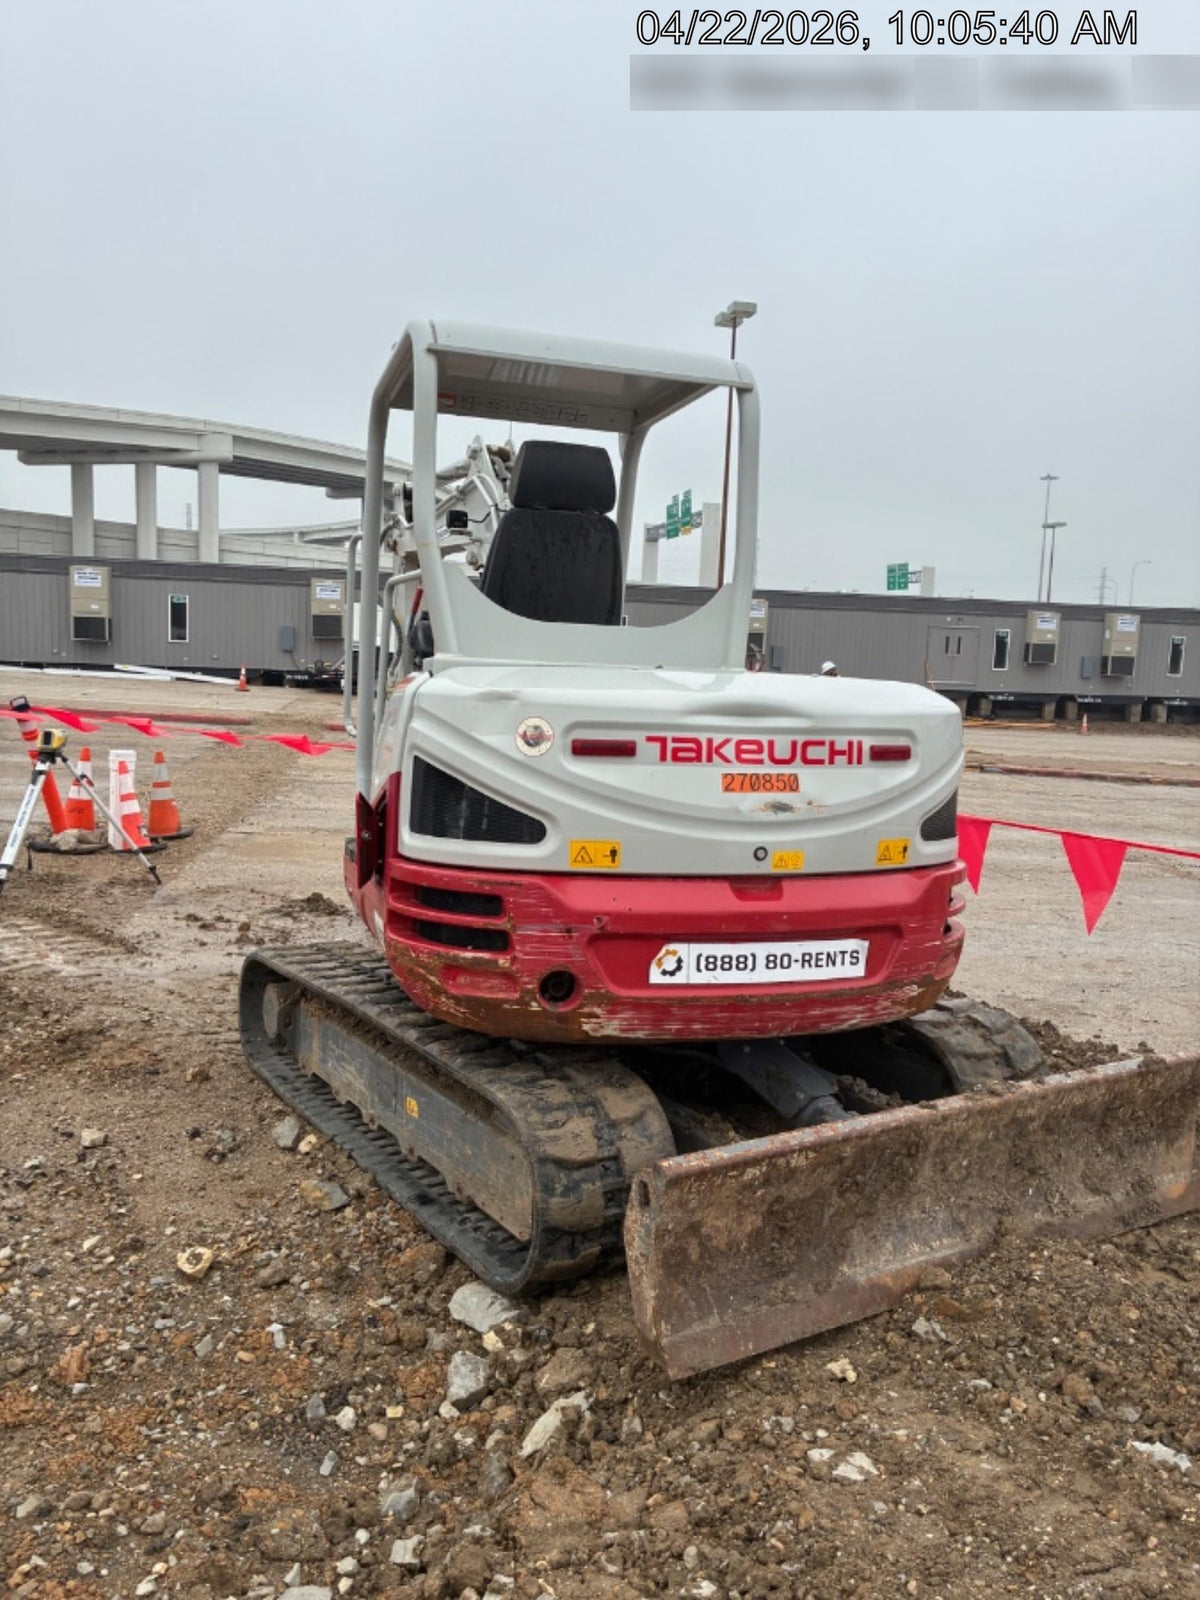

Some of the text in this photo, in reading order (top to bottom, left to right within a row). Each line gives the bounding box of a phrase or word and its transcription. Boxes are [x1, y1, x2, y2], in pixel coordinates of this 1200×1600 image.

[723, 773, 799, 792] 270850
[695, 949, 861, 974] (888) 80-RENTS
